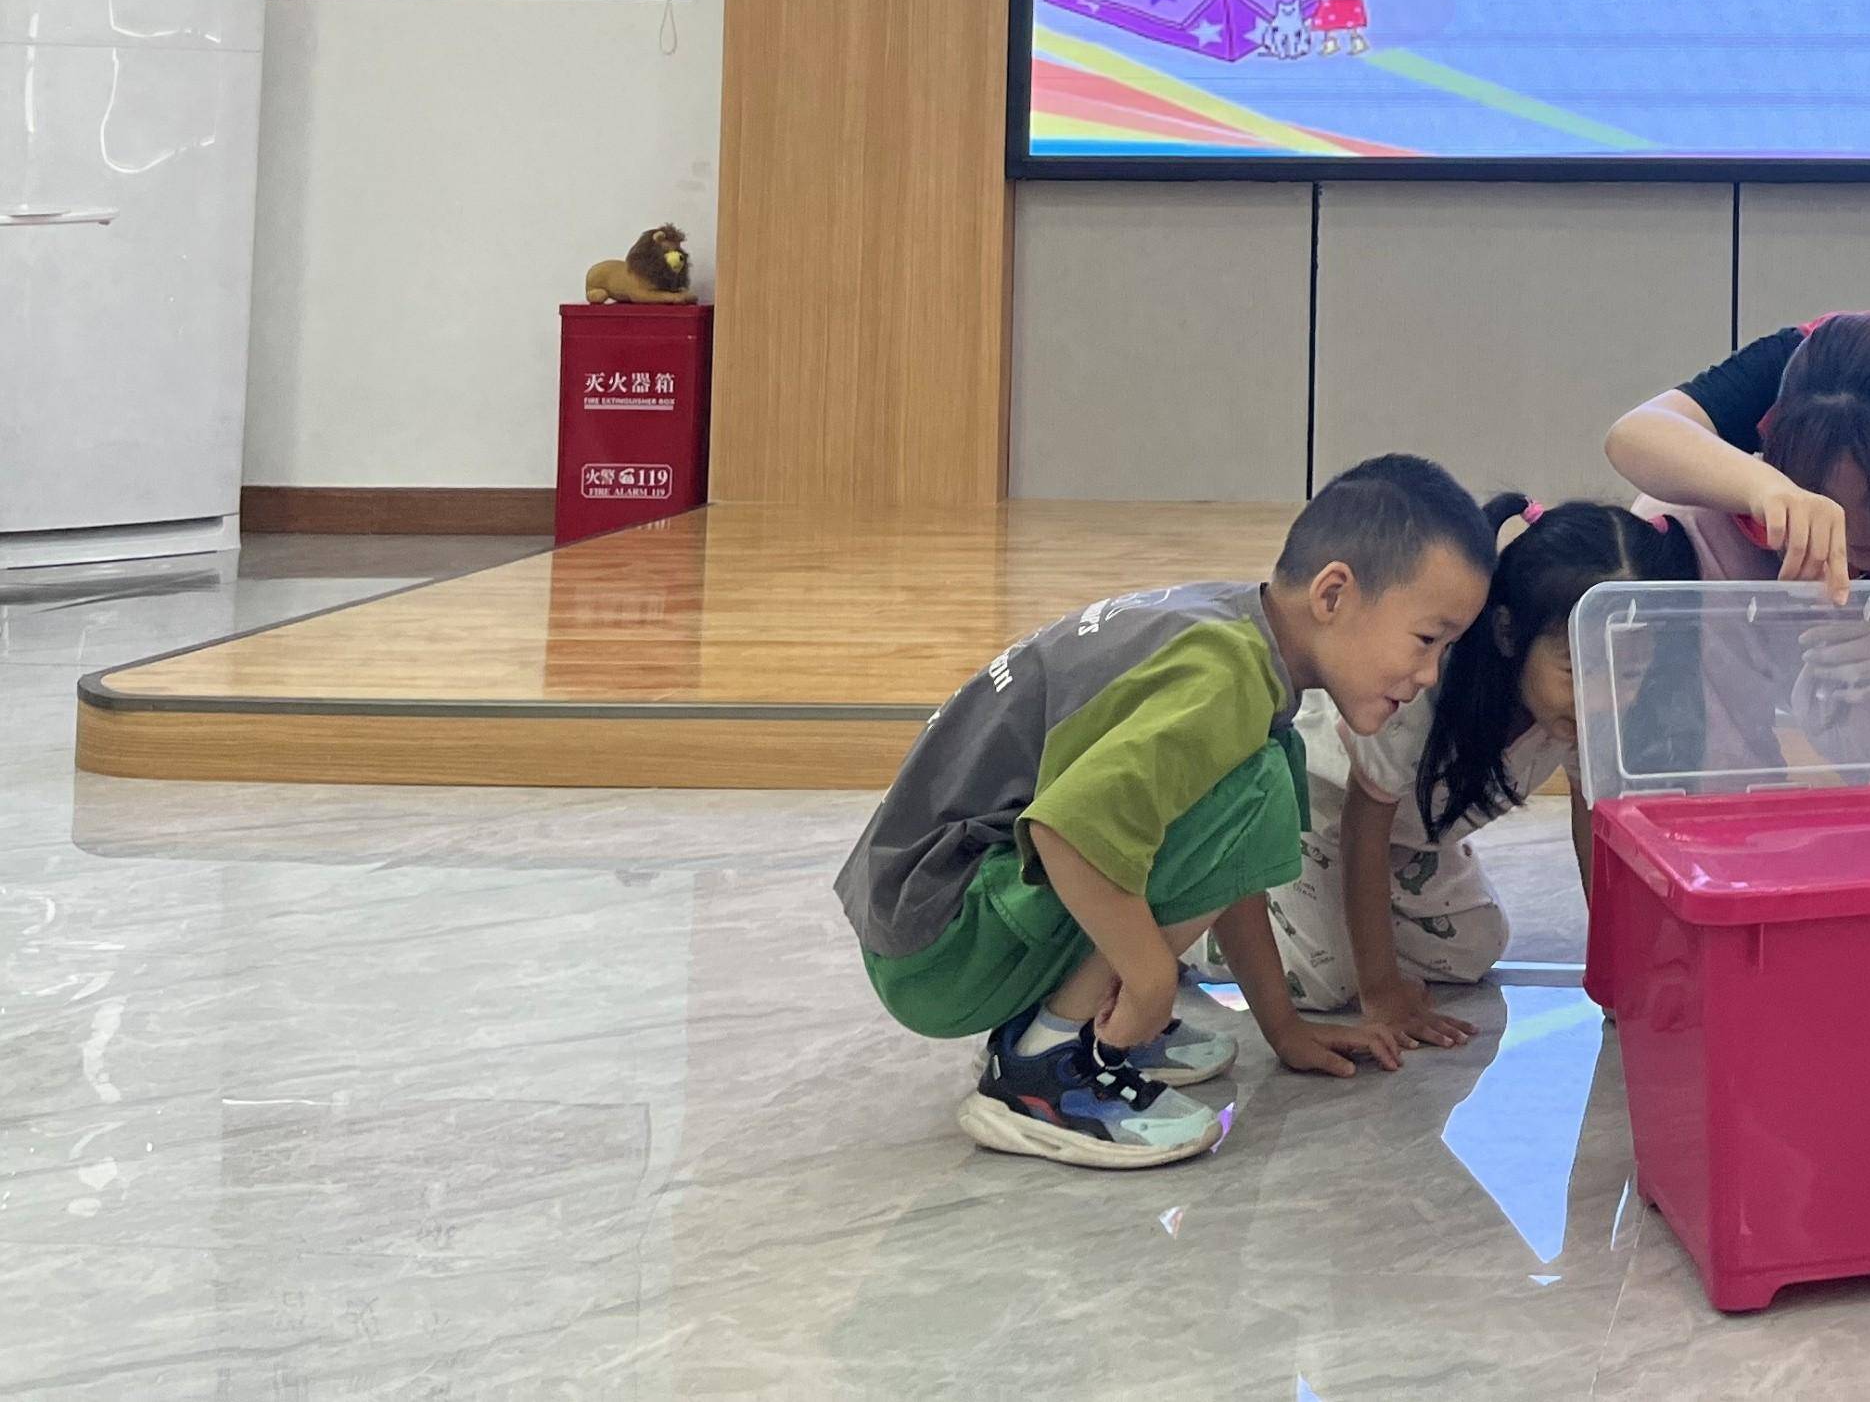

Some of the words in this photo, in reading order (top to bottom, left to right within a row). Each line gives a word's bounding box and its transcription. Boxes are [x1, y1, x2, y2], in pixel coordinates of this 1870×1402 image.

[583, 371, 675, 393] 灭火器箱
[585, 468, 616, 486] 火警
[637, 469, 668, 487] 119
[614, 488, 648, 497] ALARM
